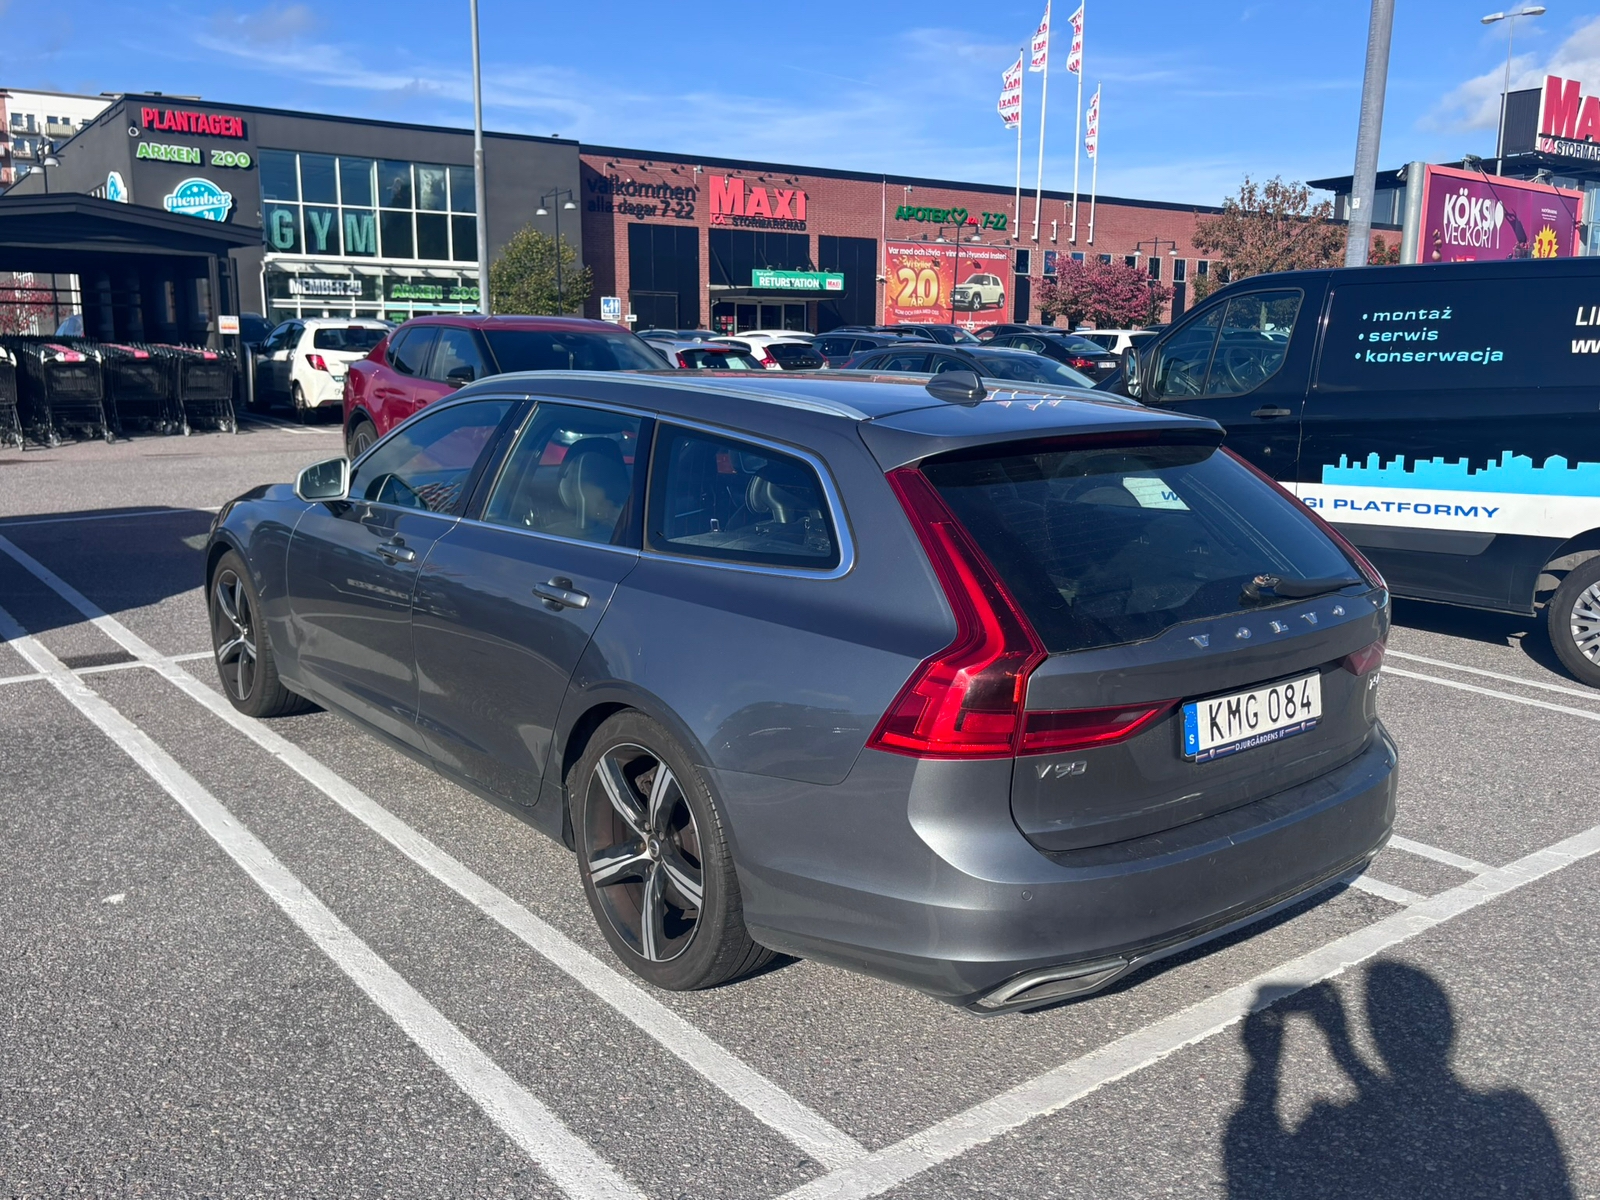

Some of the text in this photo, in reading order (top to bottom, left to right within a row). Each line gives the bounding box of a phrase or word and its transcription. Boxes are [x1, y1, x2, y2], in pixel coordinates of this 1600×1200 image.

[141, 107, 243, 137] PLANTAGEN
[136, 142, 250, 168] ARKEN ZOO
[166, 191, 230, 208] member
[587, 196, 695, 220] alla dagar 7-22
[1444, 187, 1491, 228] KÖKS
[709, 213, 807, 232] ICA STORMARKNAD
[895, 205, 951, 225] APOTEK
[982, 211, 1008, 231] 7-22
[270, 208, 376, 254] GYM
[1444, 222, 1488, 249] VECKOR
[888, 247, 900, 255] Var
[289, 278, 345, 296] MEMBER
[759, 276, 820, 288] RETURSTATION
[897, 267, 939, 307] 20
[391, 284, 481, 301] ARKEN ZOO
[910, 293, 925, 307] ÅR
[1373, 306, 1453, 321] montaż
[1369, 327, 1439, 342] serwis
[1365, 347, 1503, 365] konserwacja
[1333, 498, 1500, 518] PLATFORMY
[1188, 604, 1347, 649] VOLVO
[1208, 679, 1312, 742] KMG 084
[1189, 734, 1195, 745] S
[1235, 729, 1285, 751] DJURGÅRDENS IF
[1035, 760, 1088, 780] V90
